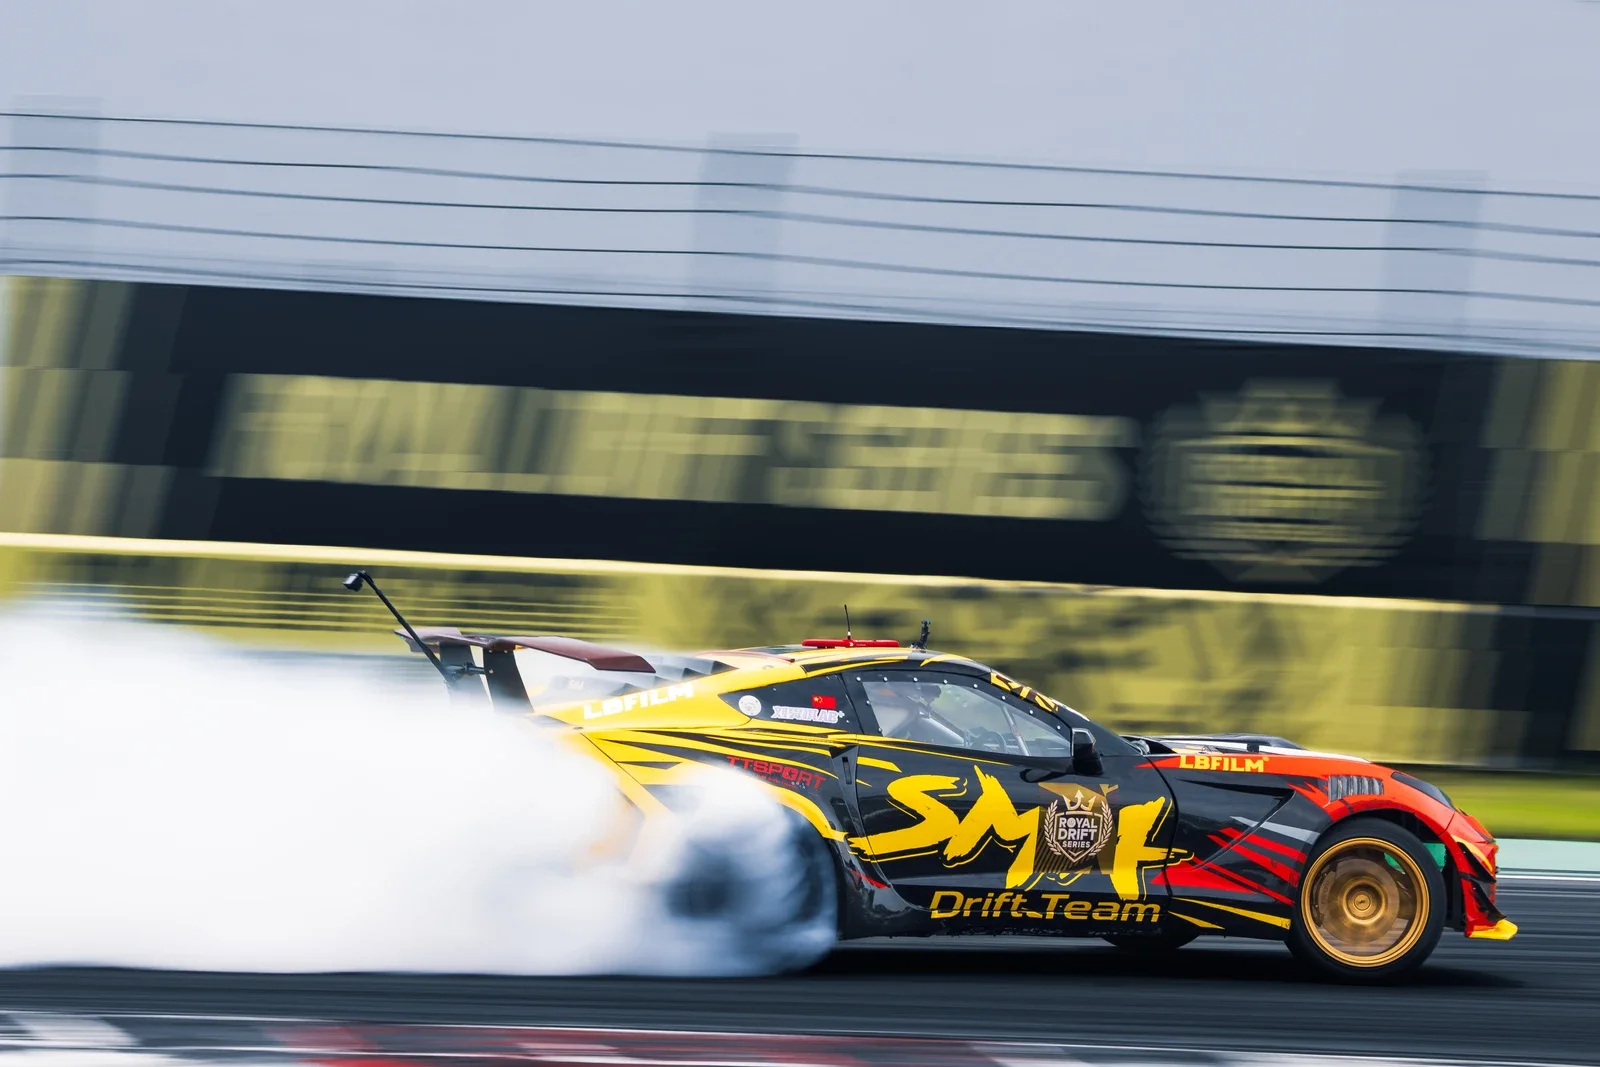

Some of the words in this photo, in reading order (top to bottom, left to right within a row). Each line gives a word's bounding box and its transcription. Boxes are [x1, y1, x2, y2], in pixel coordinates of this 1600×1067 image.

[583, 683, 693, 720] LBFILM
[726, 755, 827, 789] TTSPORT
[1179, 755, 1265, 772] LBFILM
[1058, 828, 1097, 841] DRIFT
[1059, 817, 1098, 828] ROYAL
[929, 891, 1028, 919] Drift
[1040, 893, 1161, 923] Team
